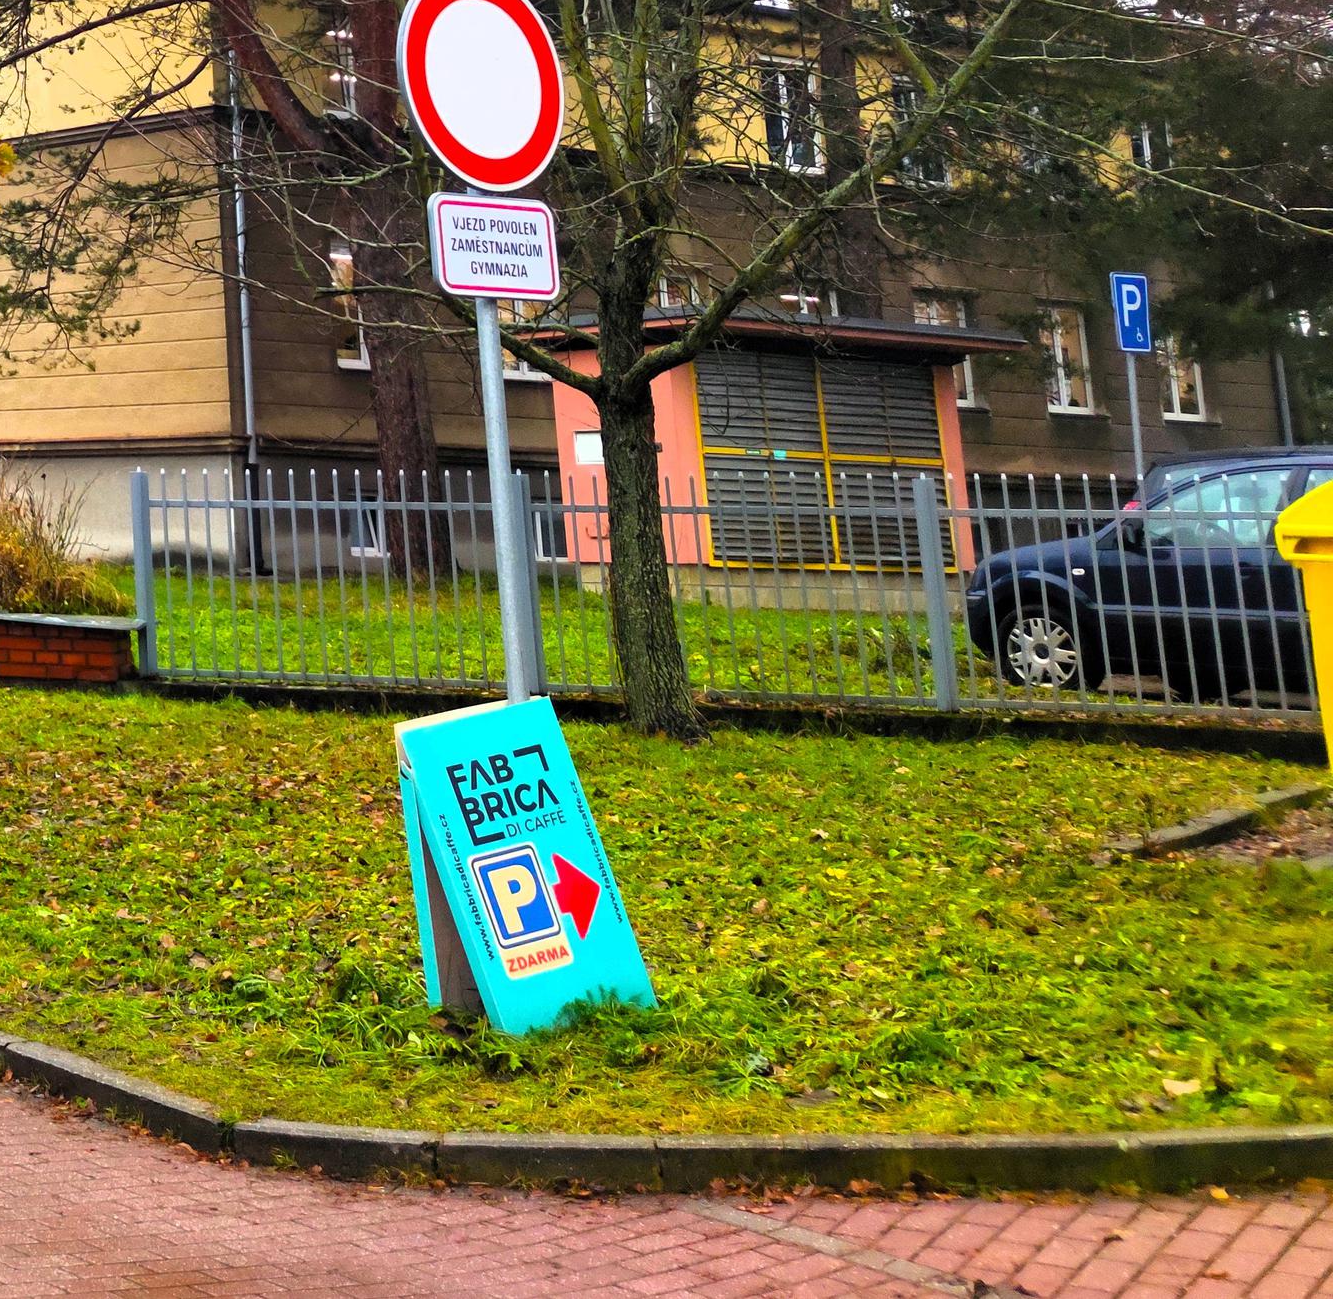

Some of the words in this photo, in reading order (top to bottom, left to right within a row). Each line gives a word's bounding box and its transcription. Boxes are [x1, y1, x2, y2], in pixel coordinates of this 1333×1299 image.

[452, 215, 486, 232] VJEZD
[490, 218, 537, 236] POVOLEN
[470, 261, 528, 278] GYMNAZIA
[1121, 284, 1141, 327] P
[506, 821, 522, 838] DI
[569, 780, 623, 924] www.fabbricadicaffe.cz
[438, 813, 495, 962] www.fabbricadicaffe.cz
[487, 864, 537, 935] P
[506, 945, 570, 973] ZDARMA
